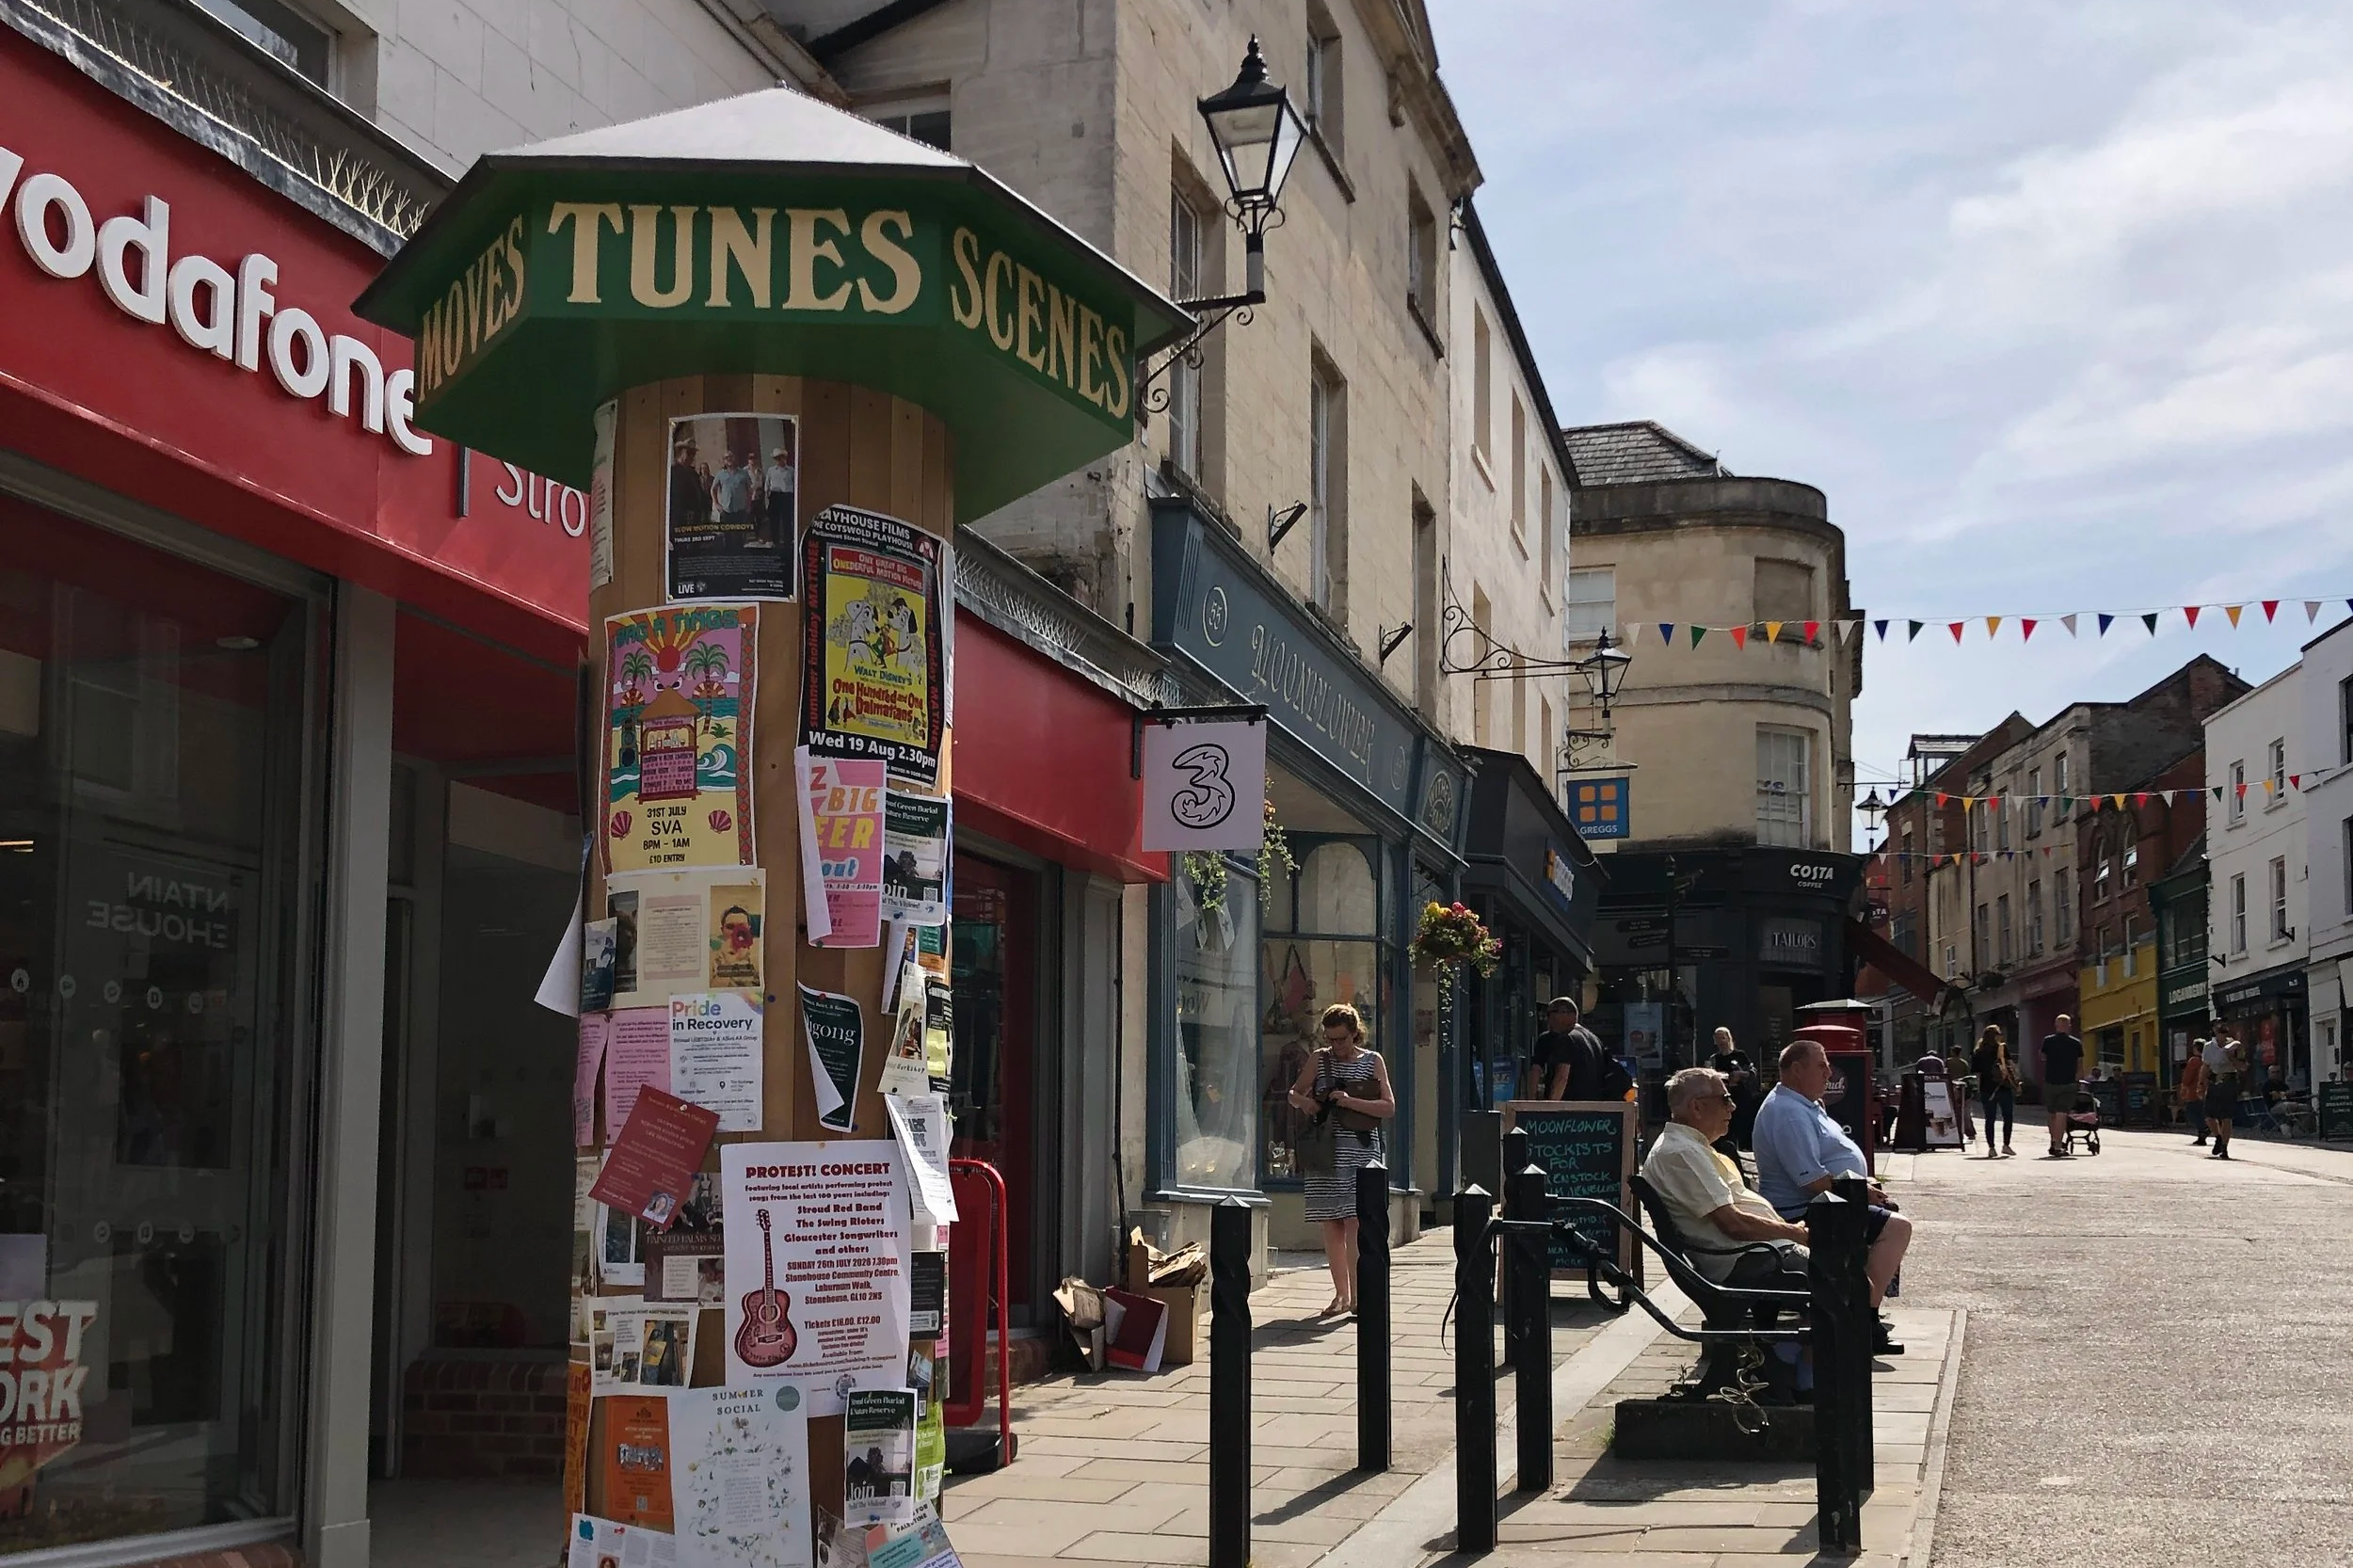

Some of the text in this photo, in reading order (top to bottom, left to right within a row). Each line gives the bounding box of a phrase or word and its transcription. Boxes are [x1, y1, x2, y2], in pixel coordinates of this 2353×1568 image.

[548, 201, 922, 314] TUNES
[419, 215, 524, 405] MOVES
[951, 226, 1130, 420] SCENES
[496, 459, 588, 537] Stro
[825, 521, 871, 537] COTSWOLD
[872, 532, 913, 551] PLAYHOUSE
[882, 521, 910, 540] FILMS
[808, 540, 819, 608] MATINEE
[678, 584, 695, 595] LIVE
[855, 664, 877, 677] WALT
[833, 679, 855, 695] One
[856, 681, 897, 704] Hundred
[856, 696, 913, 723] Dalmatians
[1251, 625, 1376, 785] MOONFLOWER
[808, 730, 936, 769] Wed 19 Aug 2.30pm
[647, 806, 687, 818] 31ST JULY
[897, 802, 938, 814] Green Burial
[903, 812, 929, 823] Reserve
[651, 820, 683, 836] SVA
[1580, 824, 1617, 835] GREGGS
[643, 838, 690, 850] 8PM 1AM
[649, 853, 685, 865] £10 ENTRY
[1790, 864, 1833, 880] COSTA
[883, 879, 908, 899] oin
[672, 1000, 722, 1017] Pride
[673, 1017, 753, 1032] in Recovery
[1525, 1118, 1616, 1135] MOONFLOWER
[745, 1162, 890, 1178] PROTEST! CONCERT
[1549, 1158, 1579, 1170] FOR
[1546, 1172, 1611, 1184] ENSTOCK
[744, 1184, 780, 1192] featuring
[800, 1182, 824, 1191] artists
[824, 1181, 866, 1191] performing
[867, 1180, 893, 1189] protest
[833, 1192, 853, 1200] years
[797, 1203, 882, 1214] Stroud Red Band
[796, 1217, 885, 1228] The Swing Rioters
[784, 1230, 898, 1242] Gloucester Songwriters
[814, 1244, 869, 1256] and others
[787, 1260, 816, 1271] SUNDAY
[817, 1259, 835, 1270] 26th
[836, 1258, 852, 1269] JULY
[872, 1256, 898, 1267] 7.30pm
[785, 1273, 830, 1283] Stonehouse
[831, 1271, 872, 1281] Community
[814, 1282, 851, 1292] Laburnum
[850, 1292, 867, 1302] GL10
[805, 1319, 831, 1329] Tickets
[717, 1403, 761, 1415] SOCIAL
[869, 1406, 896, 1415] Reserve
[15, 1423, 82, 1445] BETTER
[849, 1480, 874, 1501] Join
[916, 1503, 928, 1514] FOR
